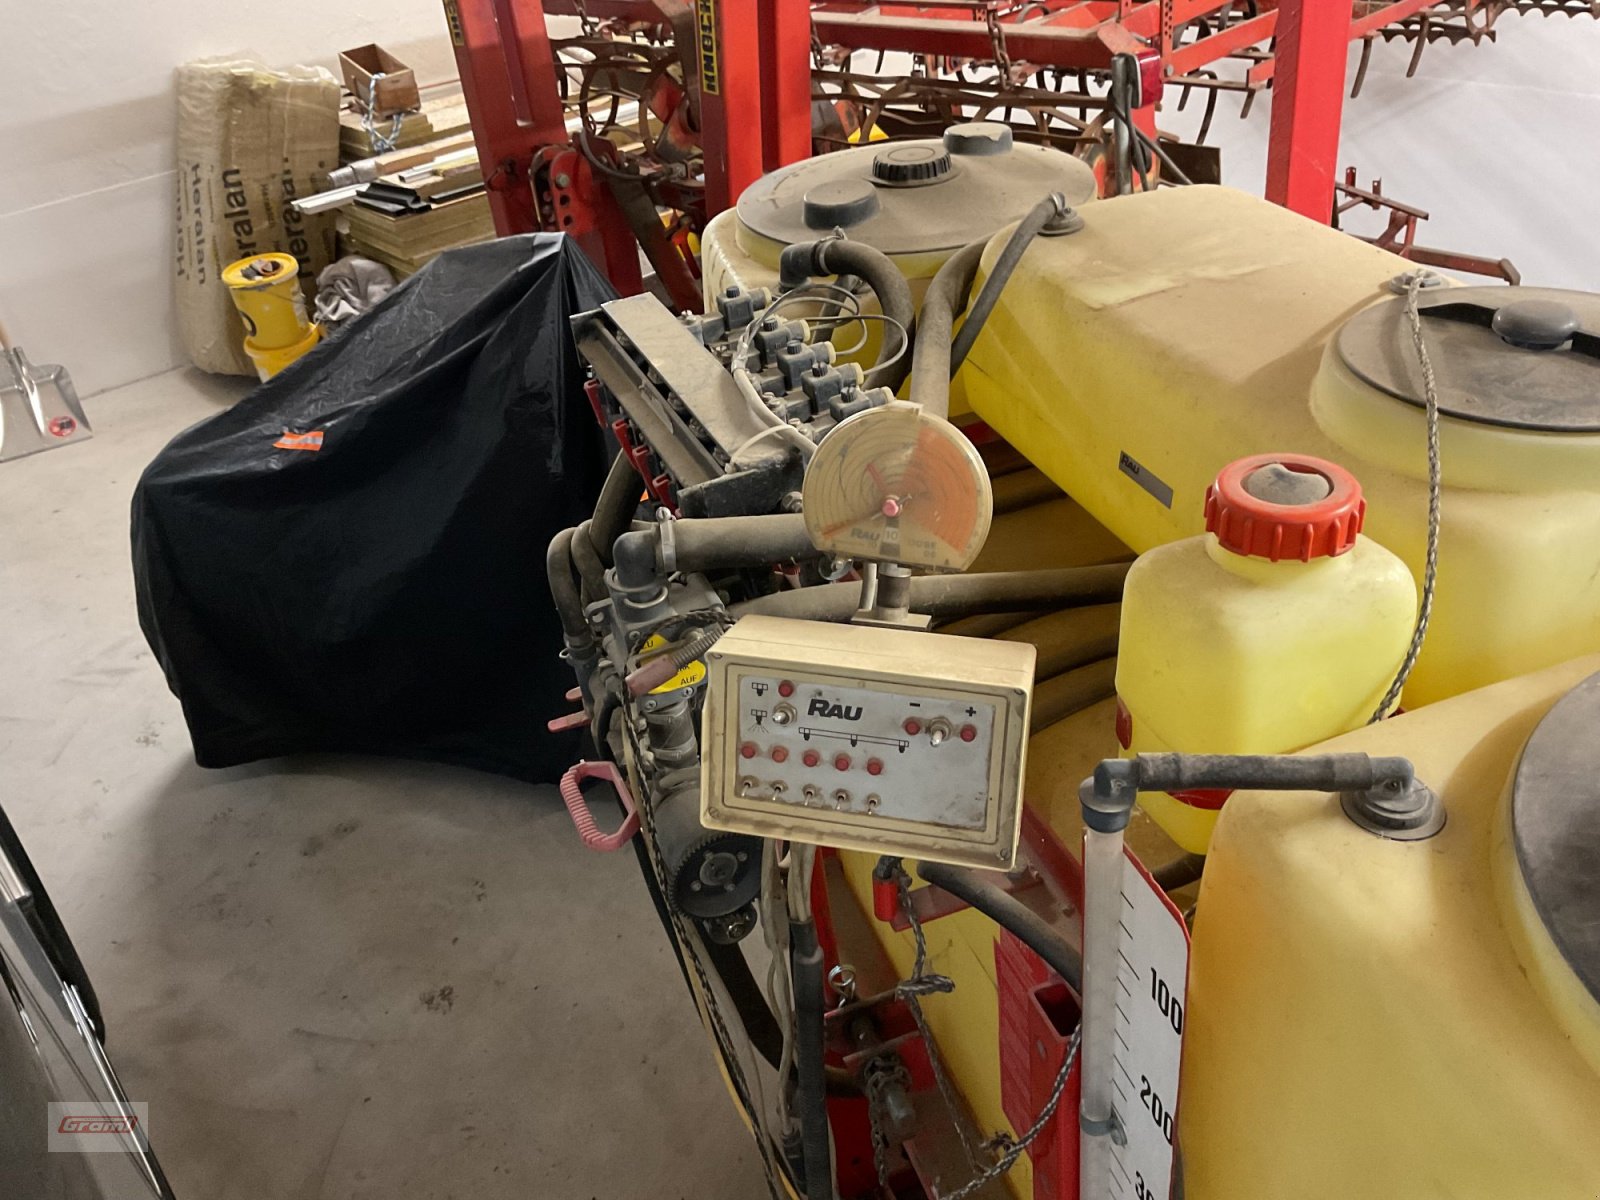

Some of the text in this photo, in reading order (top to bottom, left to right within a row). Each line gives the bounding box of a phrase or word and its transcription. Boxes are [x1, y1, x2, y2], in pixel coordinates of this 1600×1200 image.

[190, 163, 206, 286] Heralan
[1121, 454, 1140, 474] RAU
[886, 531, 898, 540] 10
[680, 674, 697, 686] AUF
[807, 697, 863, 721] RAU
[1149, 967, 1183, 1035] 100
[1140, 1075, 1174, 1146] 200
